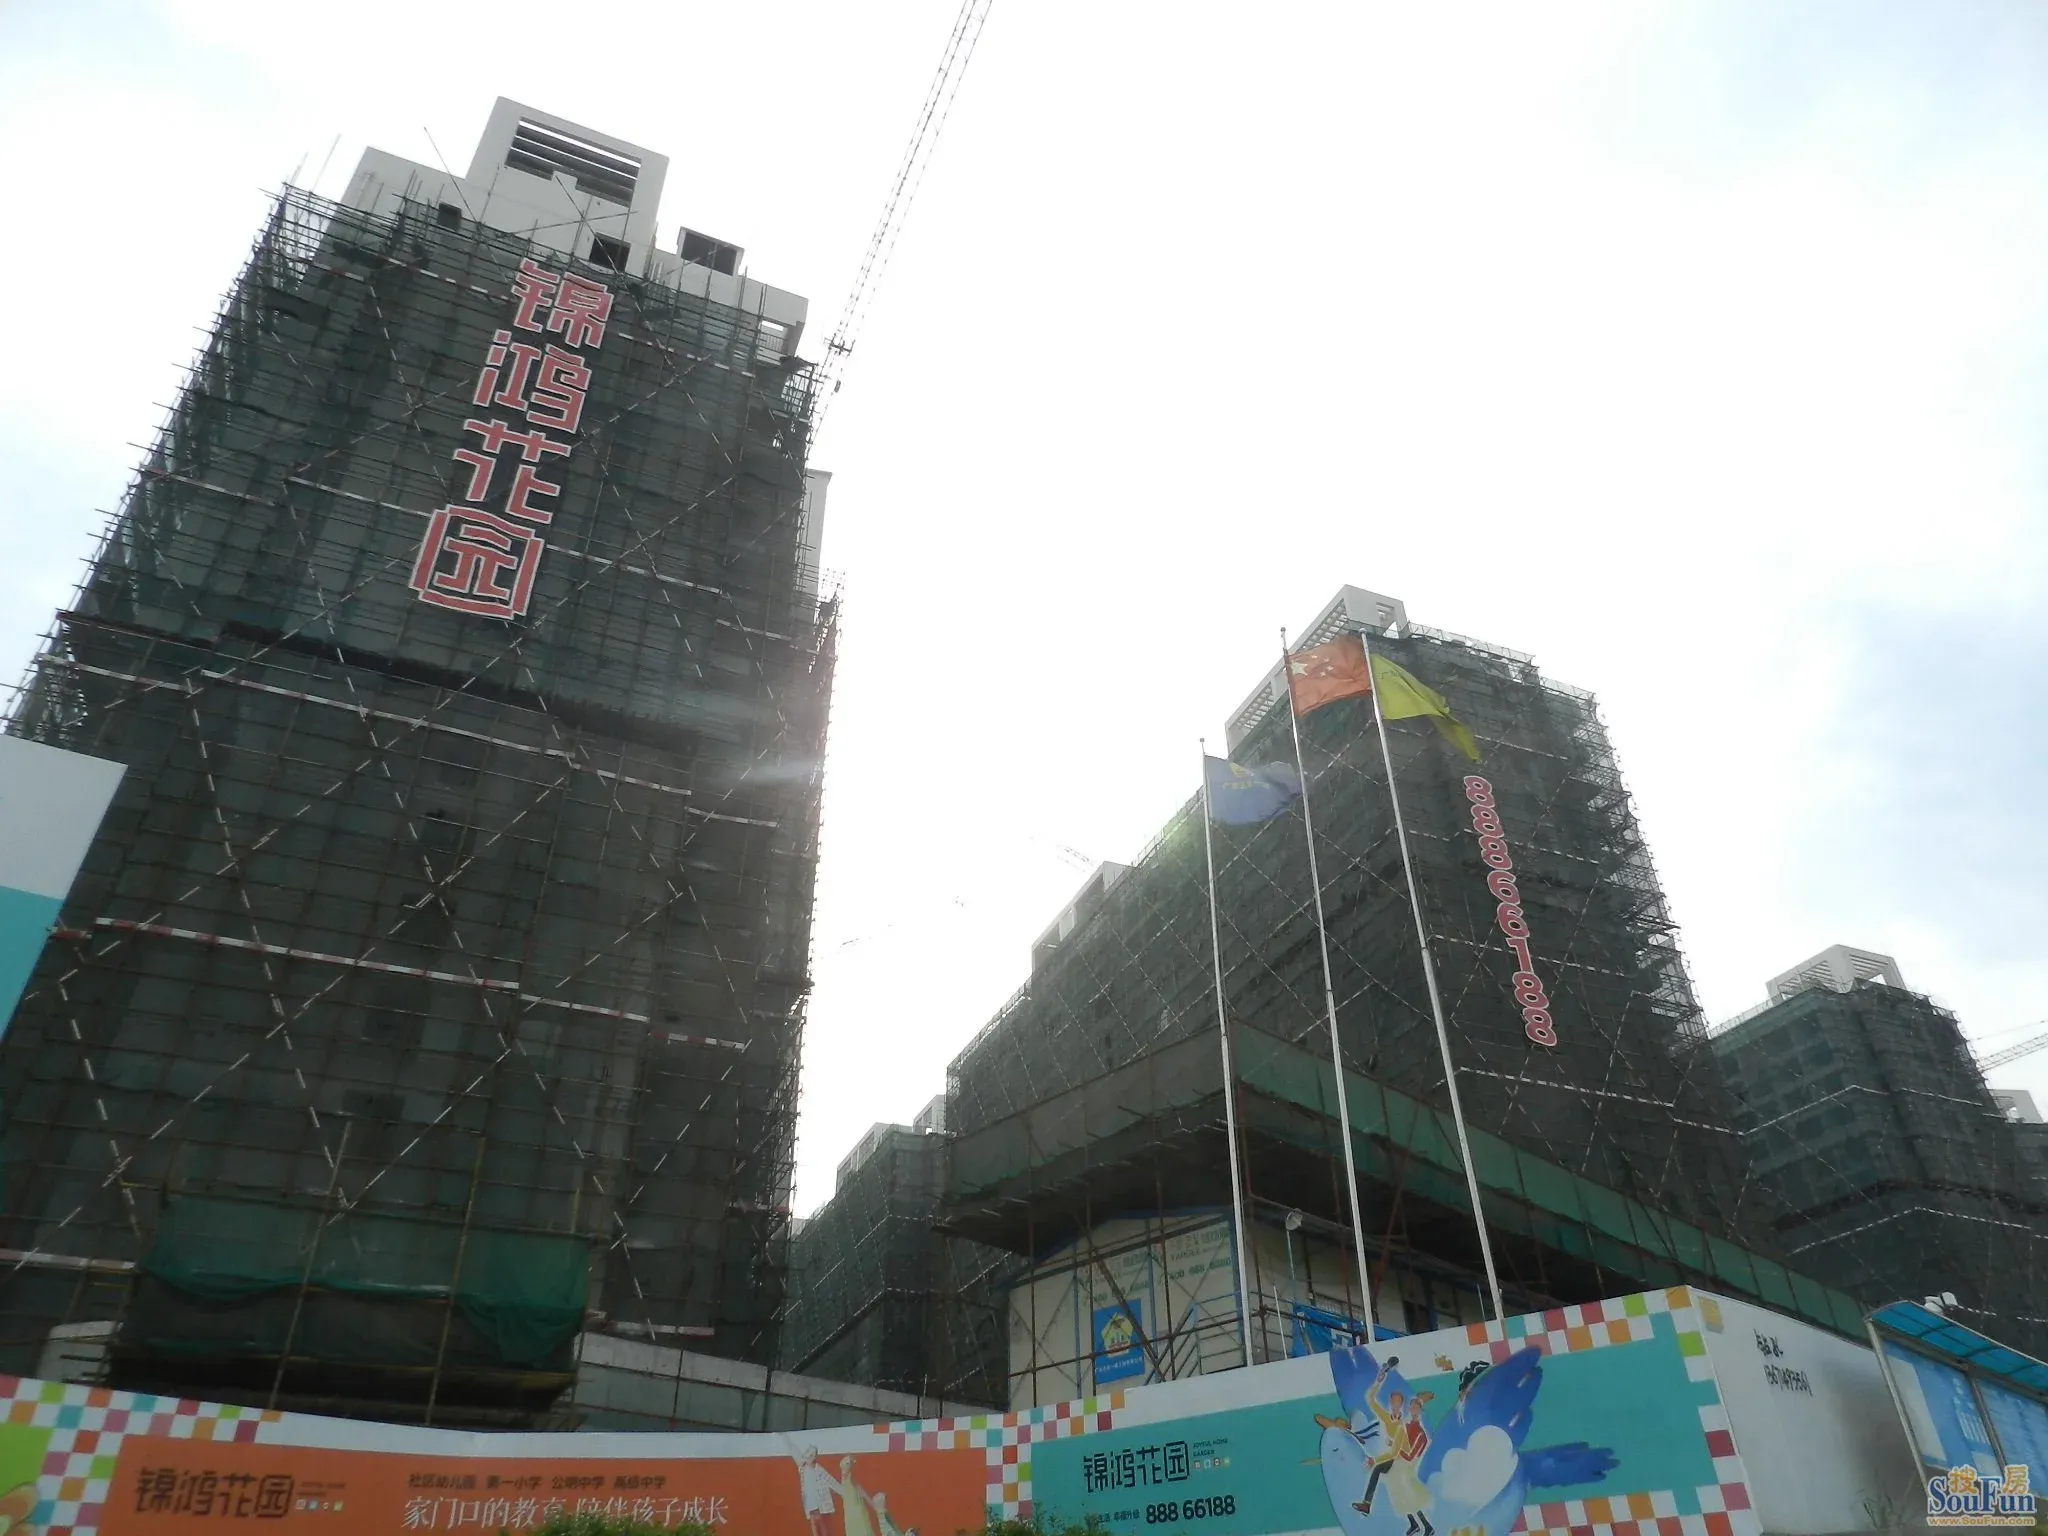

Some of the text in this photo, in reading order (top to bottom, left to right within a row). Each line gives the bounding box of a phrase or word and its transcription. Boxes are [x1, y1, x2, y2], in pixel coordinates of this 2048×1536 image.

[408, 257, 614, 621] 锦鸿花园
[1464, 775, 1558, 1047] 88866188
[134, 1467, 295, 1518] 锦鸿花园
[1083, 1440, 1190, 1493] 锦鸿花园
[1146, 1502, 1179, 1524] 888
[1183, 1495, 1236, 1519] 66188
